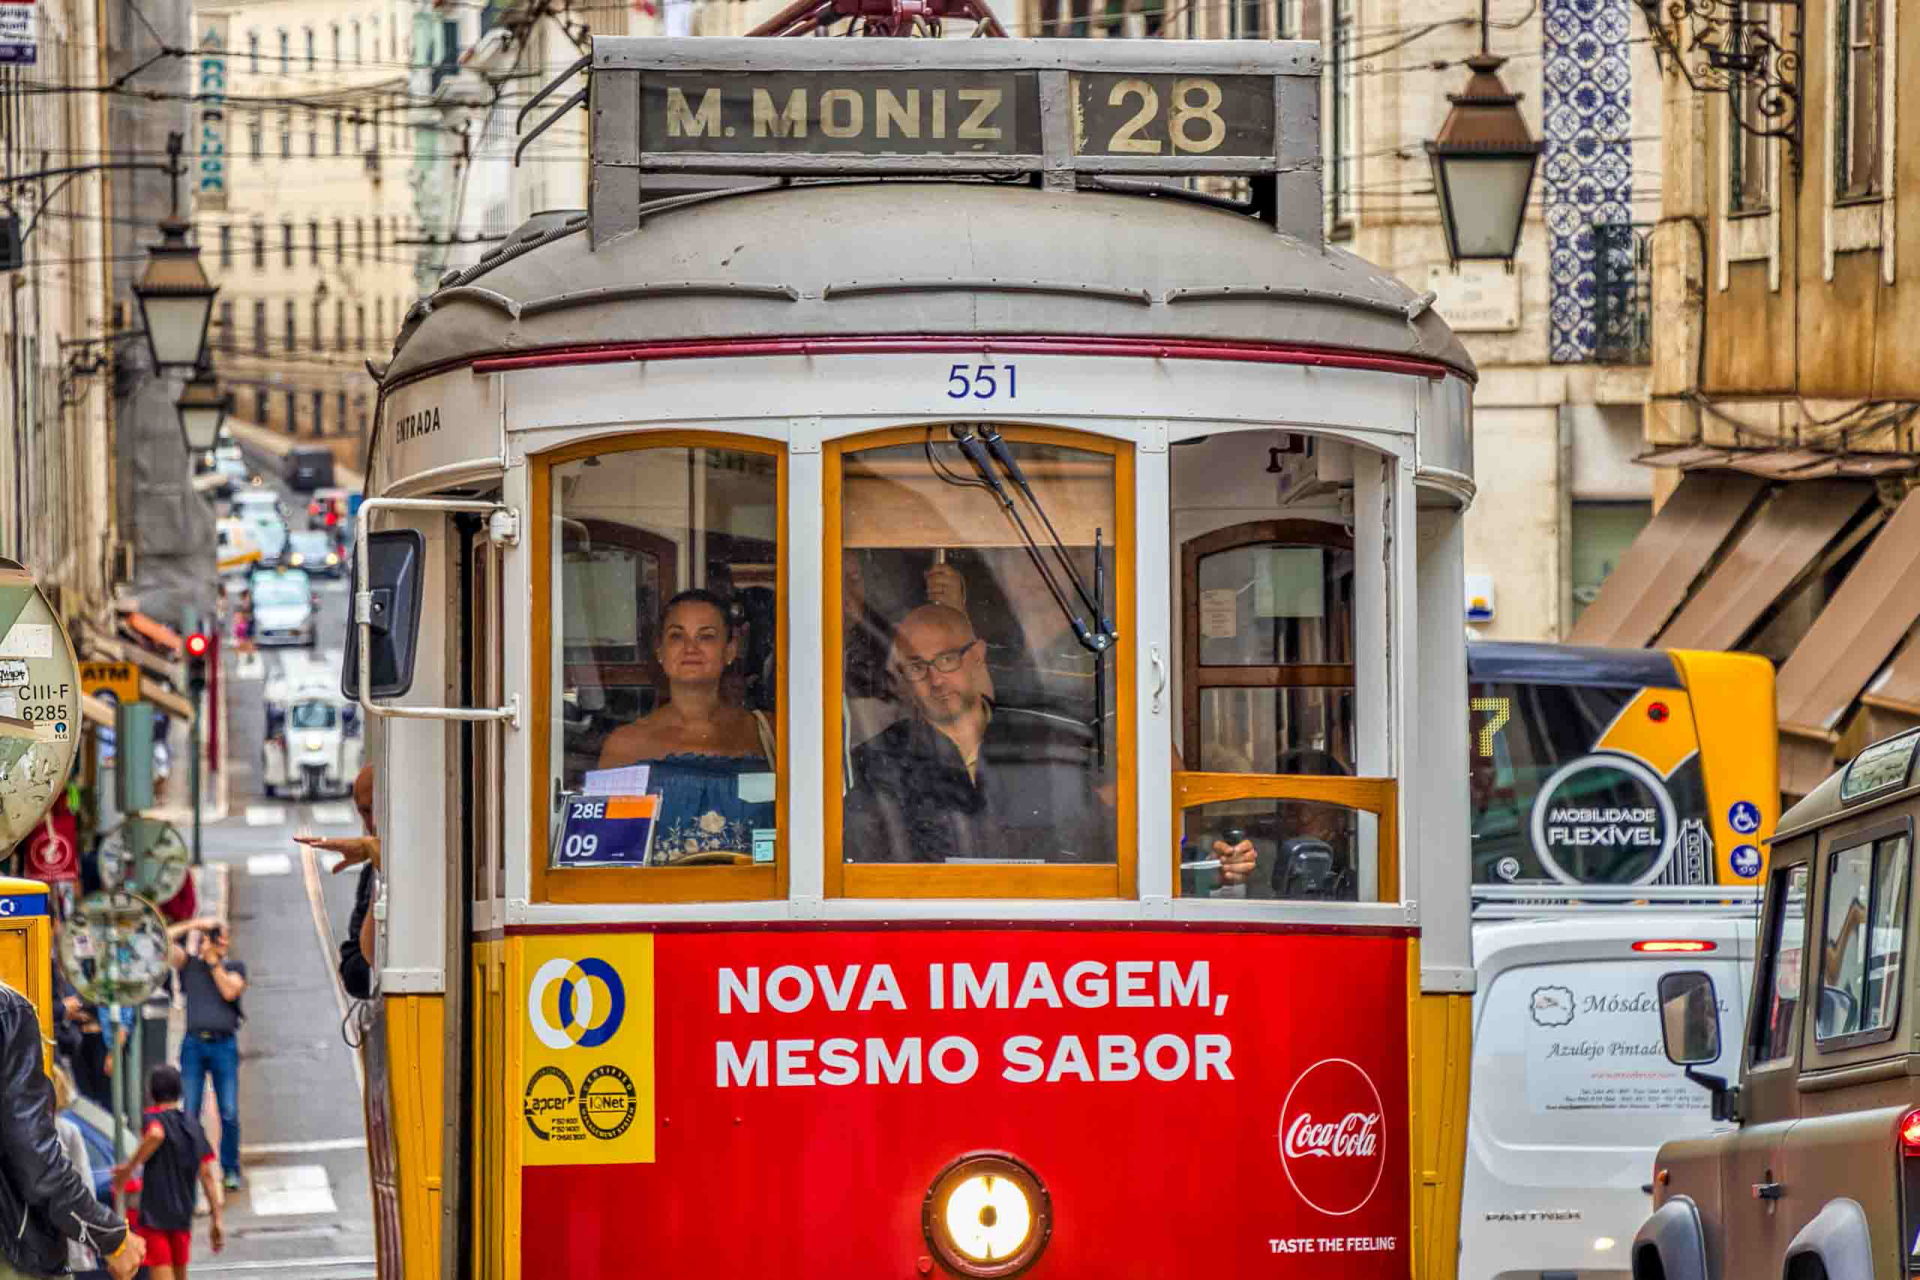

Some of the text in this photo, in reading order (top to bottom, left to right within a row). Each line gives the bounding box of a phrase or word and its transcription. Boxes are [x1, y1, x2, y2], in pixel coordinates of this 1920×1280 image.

[667, 88, 1002, 139] M. MONIZ
[1108, 79, 1227, 154] 28
[947, 364, 1016, 399] 551
[396, 406, 441, 444] ENTRADA
[83, 665, 130, 681] ATM
[19, 684, 69, 700] CIII-F
[23, 705, 67, 720] 6285
[572, 803, 605, 819] 28E
[1549, 808, 1656, 823] MOBILIDADE
[1548, 823, 1662, 846] FLEXÍVEL
[565, 834, 599, 858] 09
[718, 960, 1229, 1016] NOVA IMAGEM,
[716, 1033, 1235, 1088] MESMO SABOR
[1546, 1040, 1604, 1061] Azulejo
[532, 1097, 567, 1116] apcer
[589, 1096, 625, 1110] IQNet
[1285, 1112, 1381, 1158] Coca-Cola
[1268, 1237, 1395, 1253] TASTE THE FEELING
